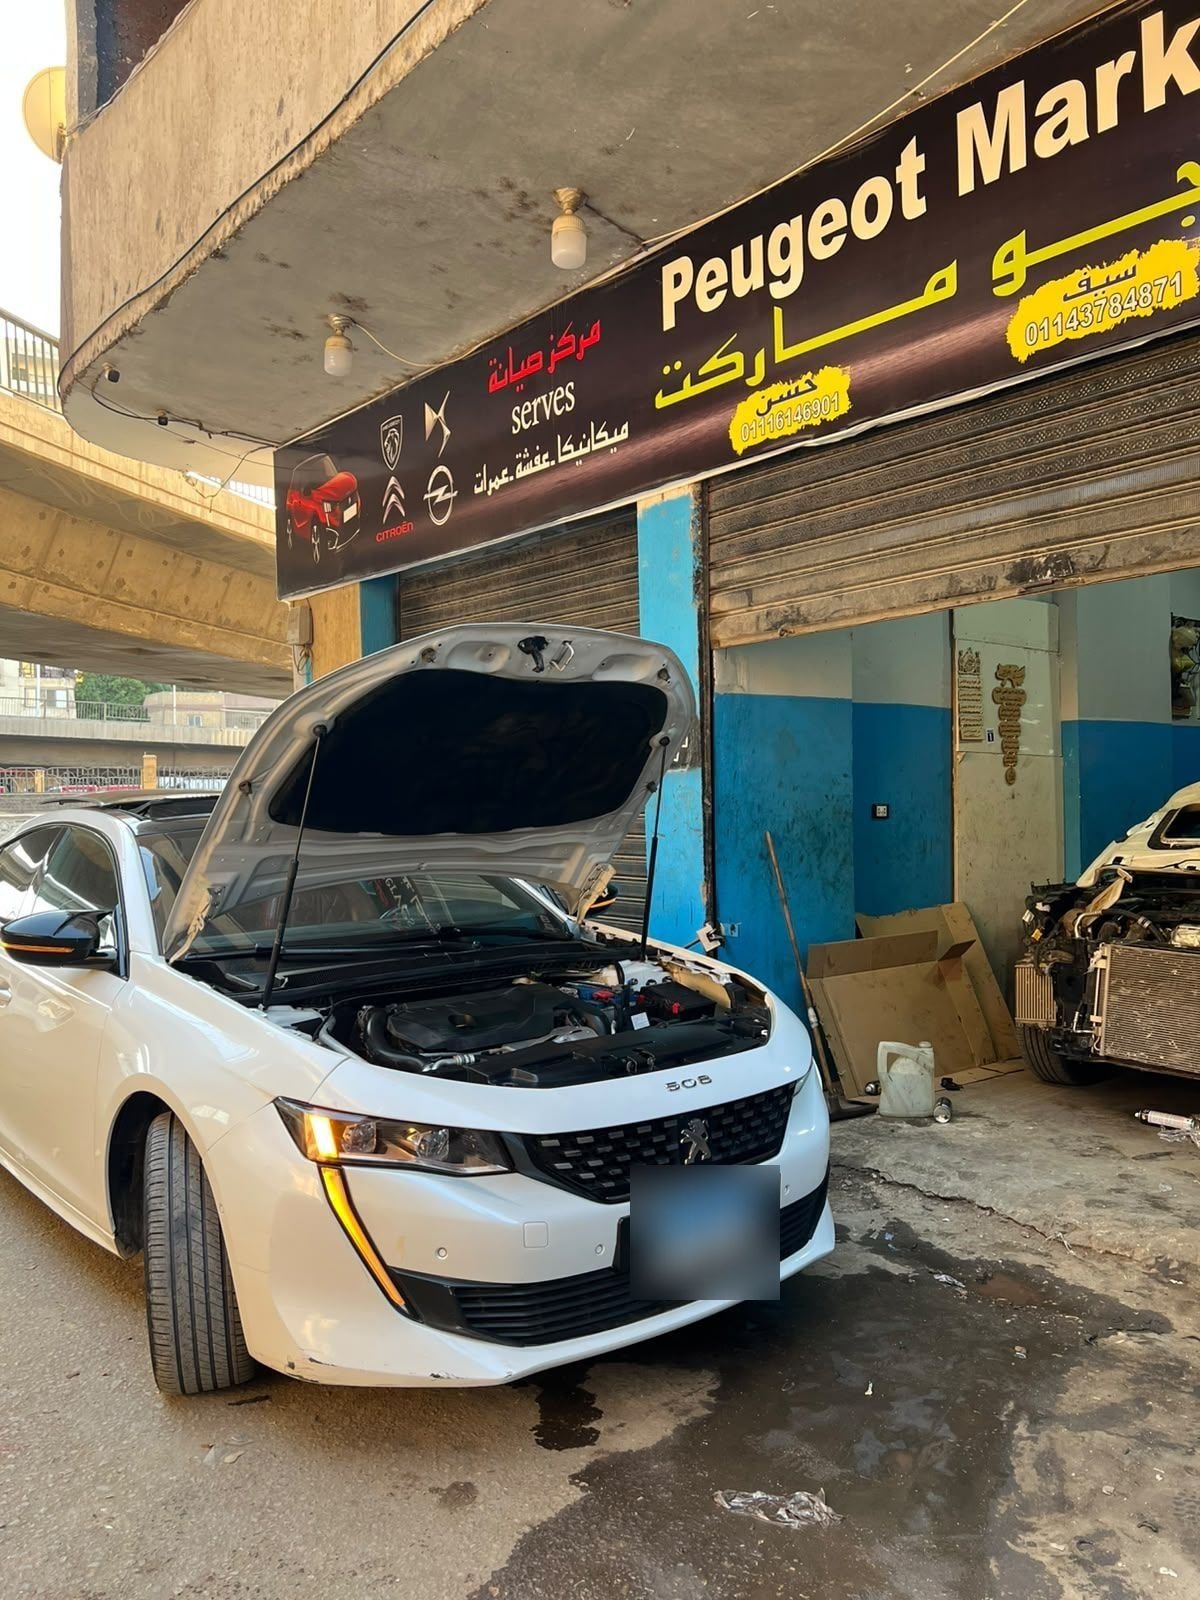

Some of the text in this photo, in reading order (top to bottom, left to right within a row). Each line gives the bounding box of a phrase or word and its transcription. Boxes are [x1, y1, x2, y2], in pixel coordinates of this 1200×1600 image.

[662, 10, 1200, 332] Peugeot Mark
[1025, 271, 1182, 346] 01143784871
[1063, 264, 1137, 302] سيف
[488, 320, 601, 393] مركز صيانة
[655, 258, 958, 409] ماركت
[511, 381, 576, 434] serves
[740, 391, 840, 442] 01116146901
[756, 378, 818, 417] حسن
[557, 420, 629, 467] ميكانيكا
[375, 521, 414, 543] CITROËN
[664, 1074, 713, 1092] 508
